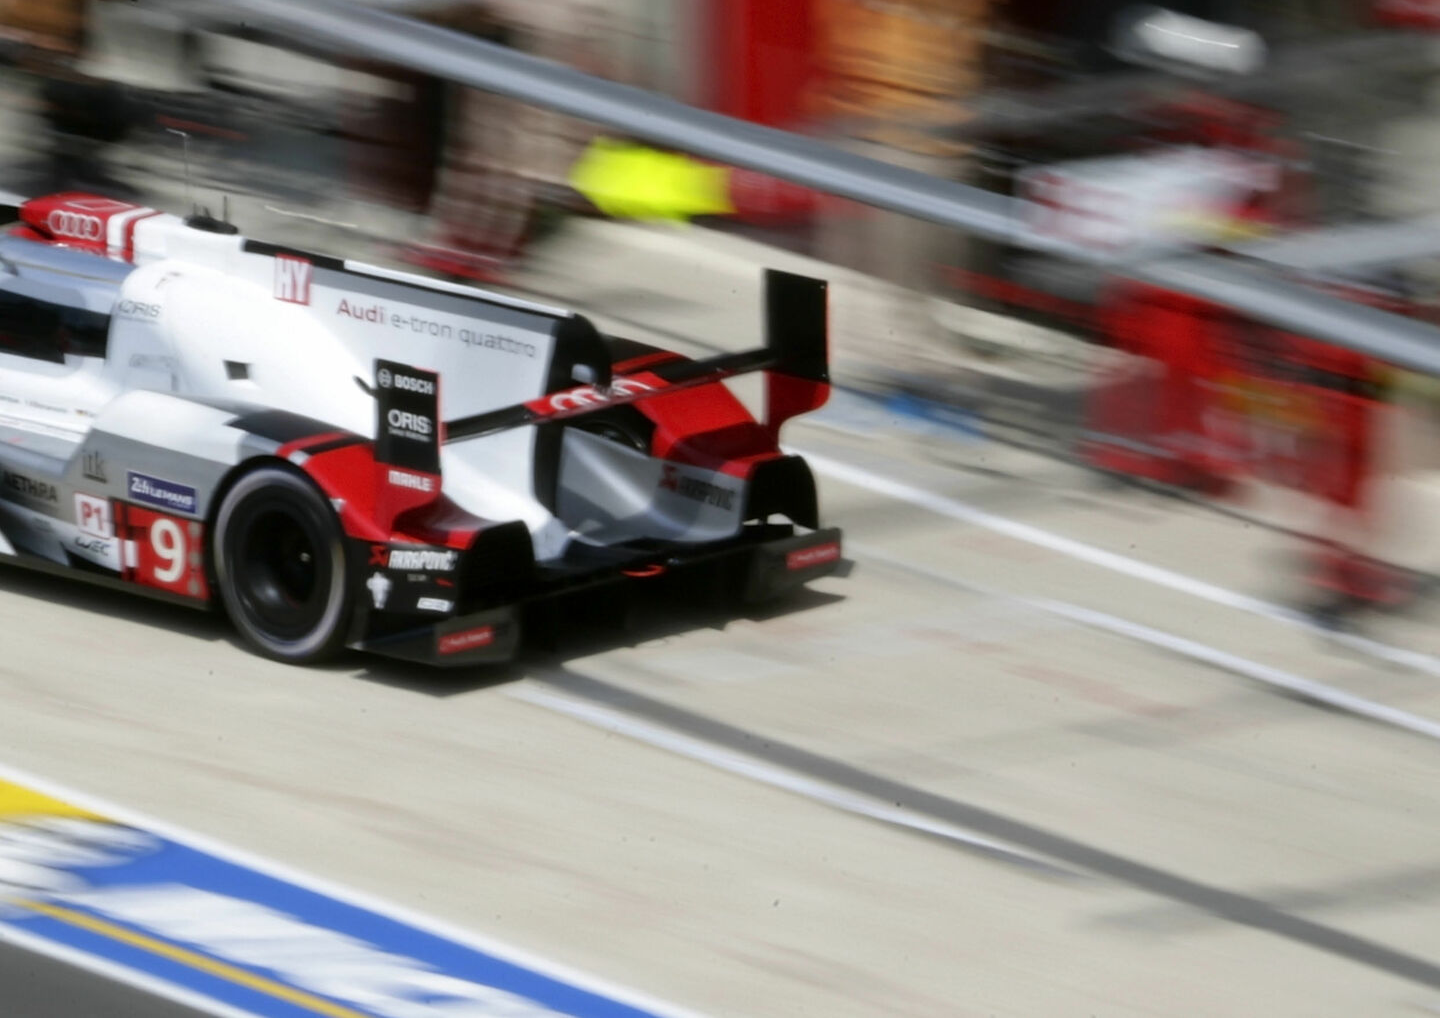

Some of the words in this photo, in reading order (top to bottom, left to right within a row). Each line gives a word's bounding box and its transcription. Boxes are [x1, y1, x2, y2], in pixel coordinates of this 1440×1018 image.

[275, 259, 309, 304] HY
[337, 298, 385, 325] Audi
[391, 313, 453, 339] e-tron
[460, 328, 536, 358] quattro
[394, 374, 434, 395] BOSCH
[388, 409, 433, 435] ORIS
[388, 470, 433, 492] MAHLE
[81, 500, 106, 531] P1
[74, 535, 111, 556] WEC
[150, 517, 187, 583] 9
